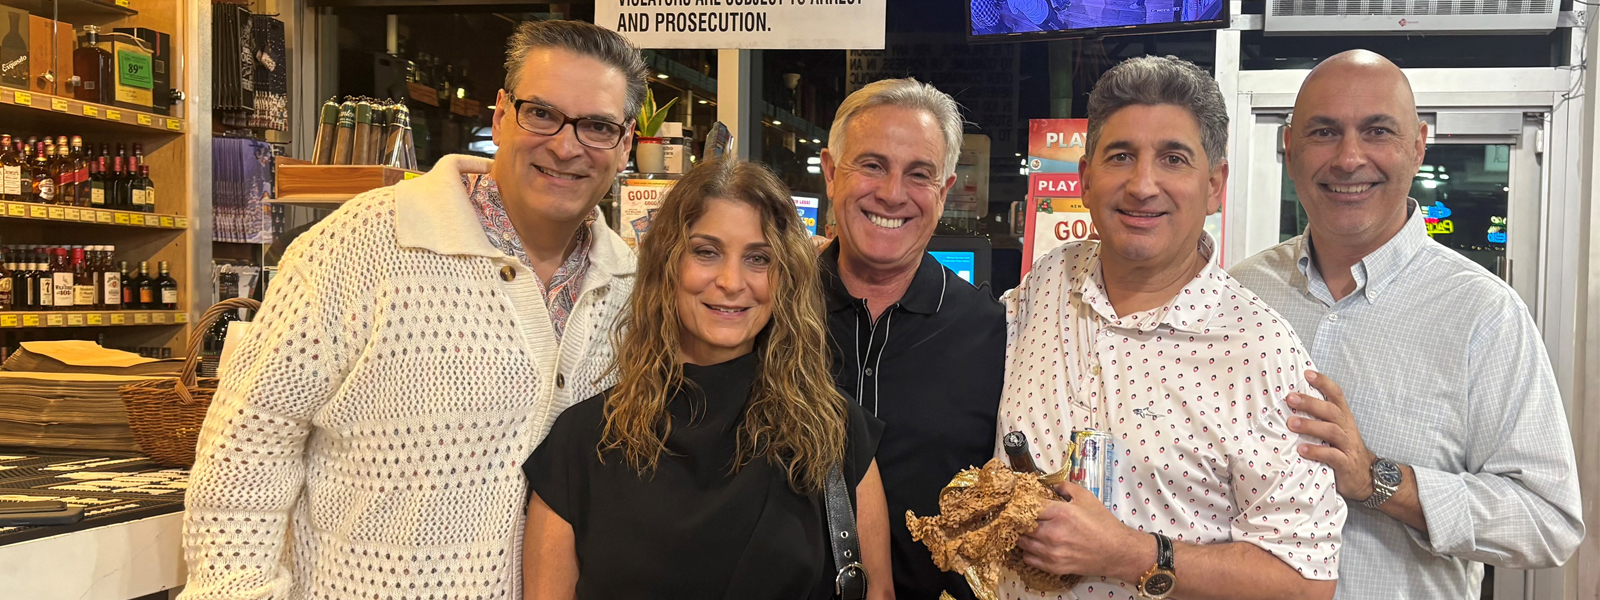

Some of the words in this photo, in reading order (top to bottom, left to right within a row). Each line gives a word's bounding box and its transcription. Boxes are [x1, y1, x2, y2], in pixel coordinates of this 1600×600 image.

[617, 12, 650, 33] AND
[655, 11, 772, 33] PROSECUTION.
[128, 63, 139, 74] 89
[1038, 180, 1078, 192] PLAY
[627, 189, 658, 201] GOOD
